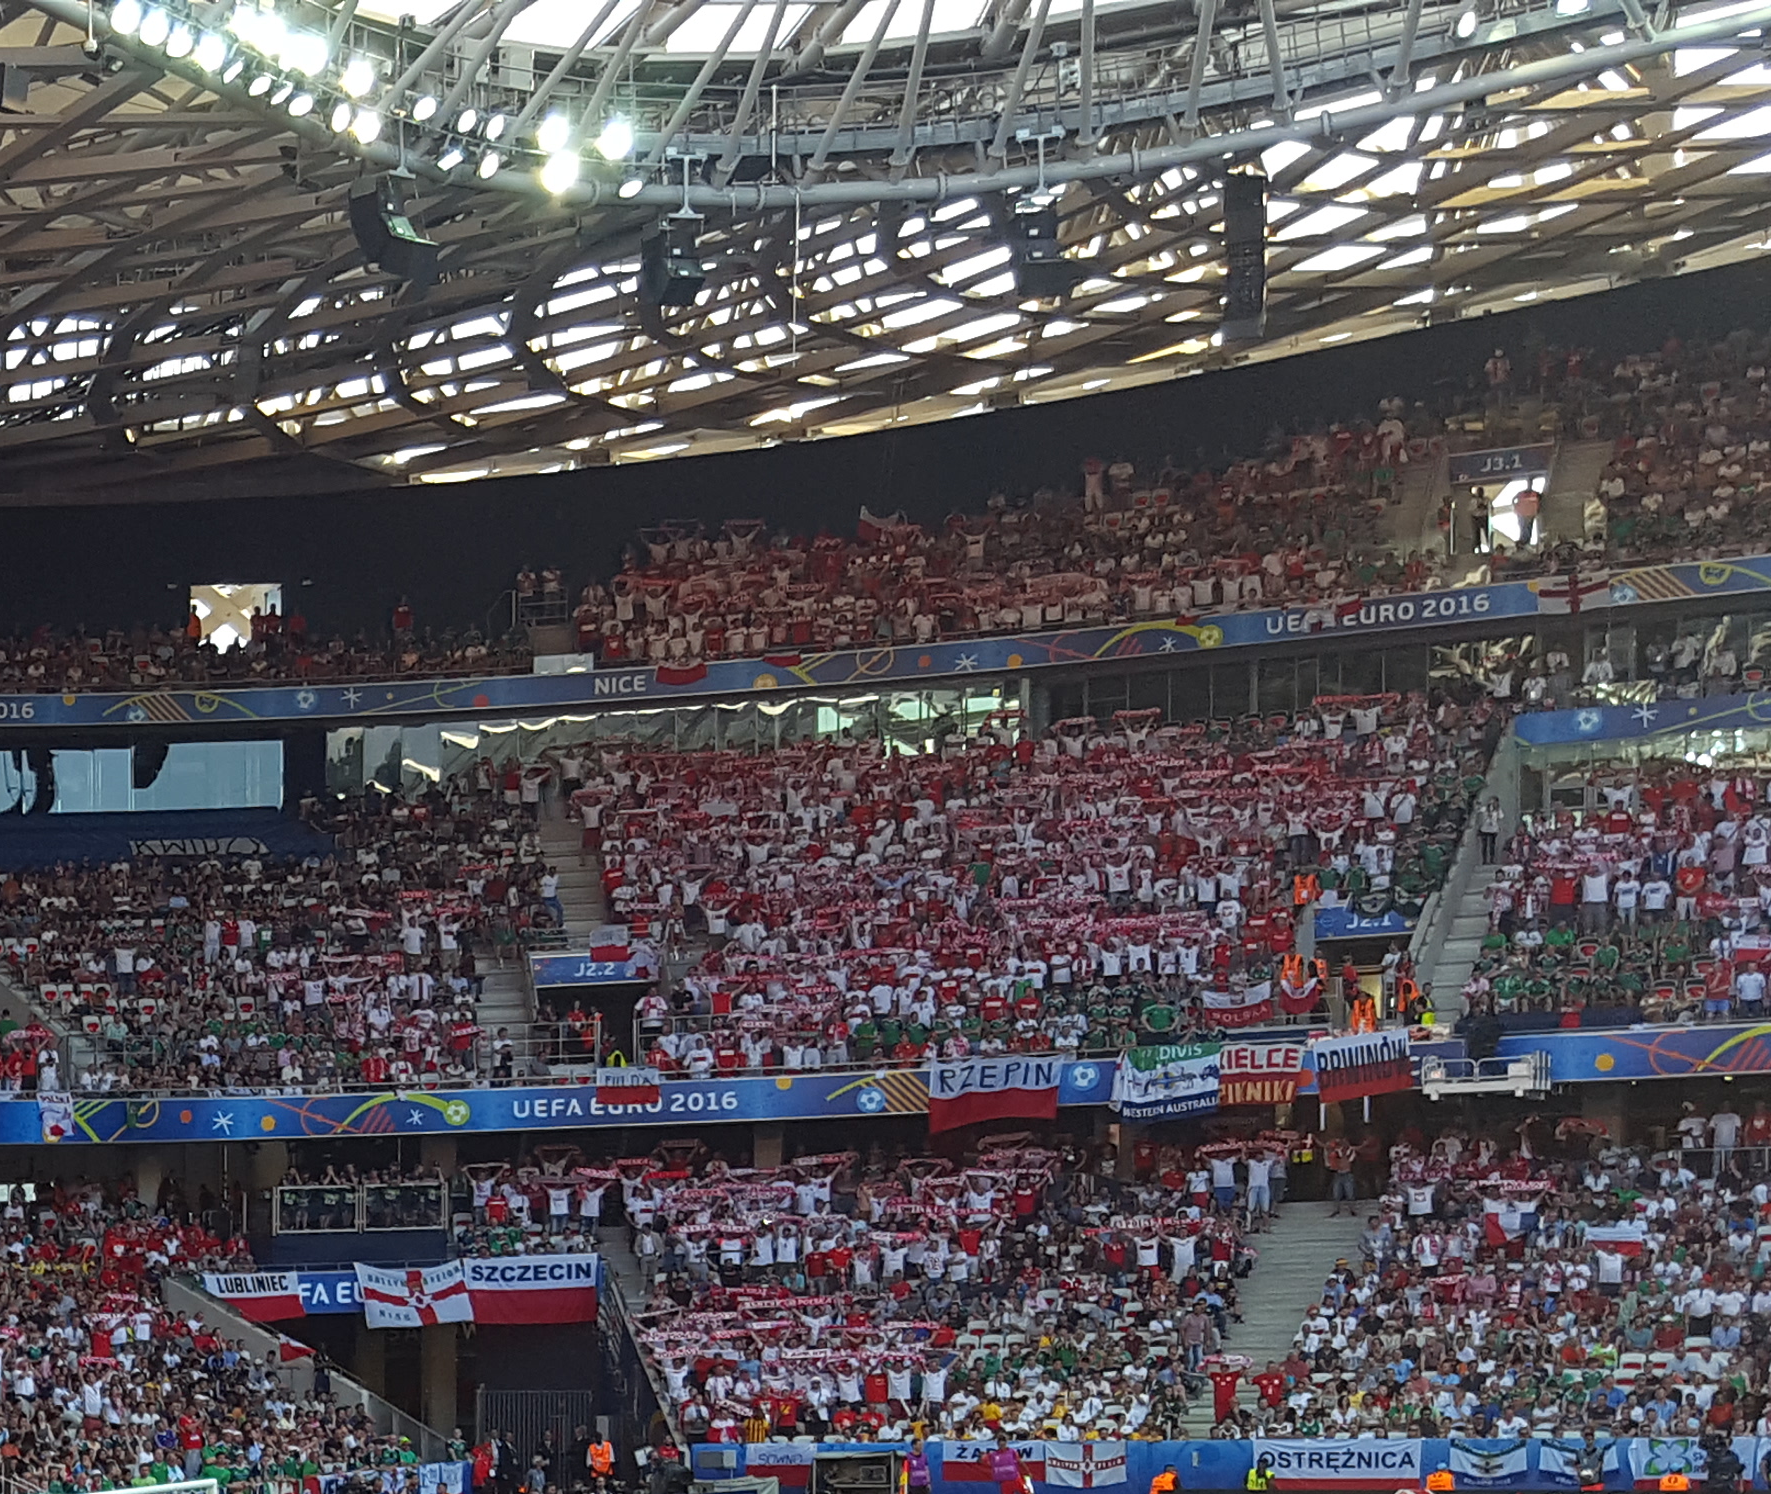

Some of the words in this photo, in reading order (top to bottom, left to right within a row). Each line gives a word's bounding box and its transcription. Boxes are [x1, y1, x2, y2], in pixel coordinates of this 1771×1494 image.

[1479, 454, 1523, 473] J3.1
[1343, 602, 1415, 626] EURO
[1421, 593, 1491, 617] 2016
[593, 675, 647, 694] NICE
[573, 963, 616, 978] J2.2
[939, 1061, 1054, 1094] RZEPIN
[512, 1097, 584, 1118] UEFA
[669, 1091, 739, 1113] 2016
[470, 1262, 593, 1283] SZCZECIN
[216, 1274, 289, 1295] LUBLINIEC
[1258, 1448, 1416, 1474] OSTRĘŻNICA
